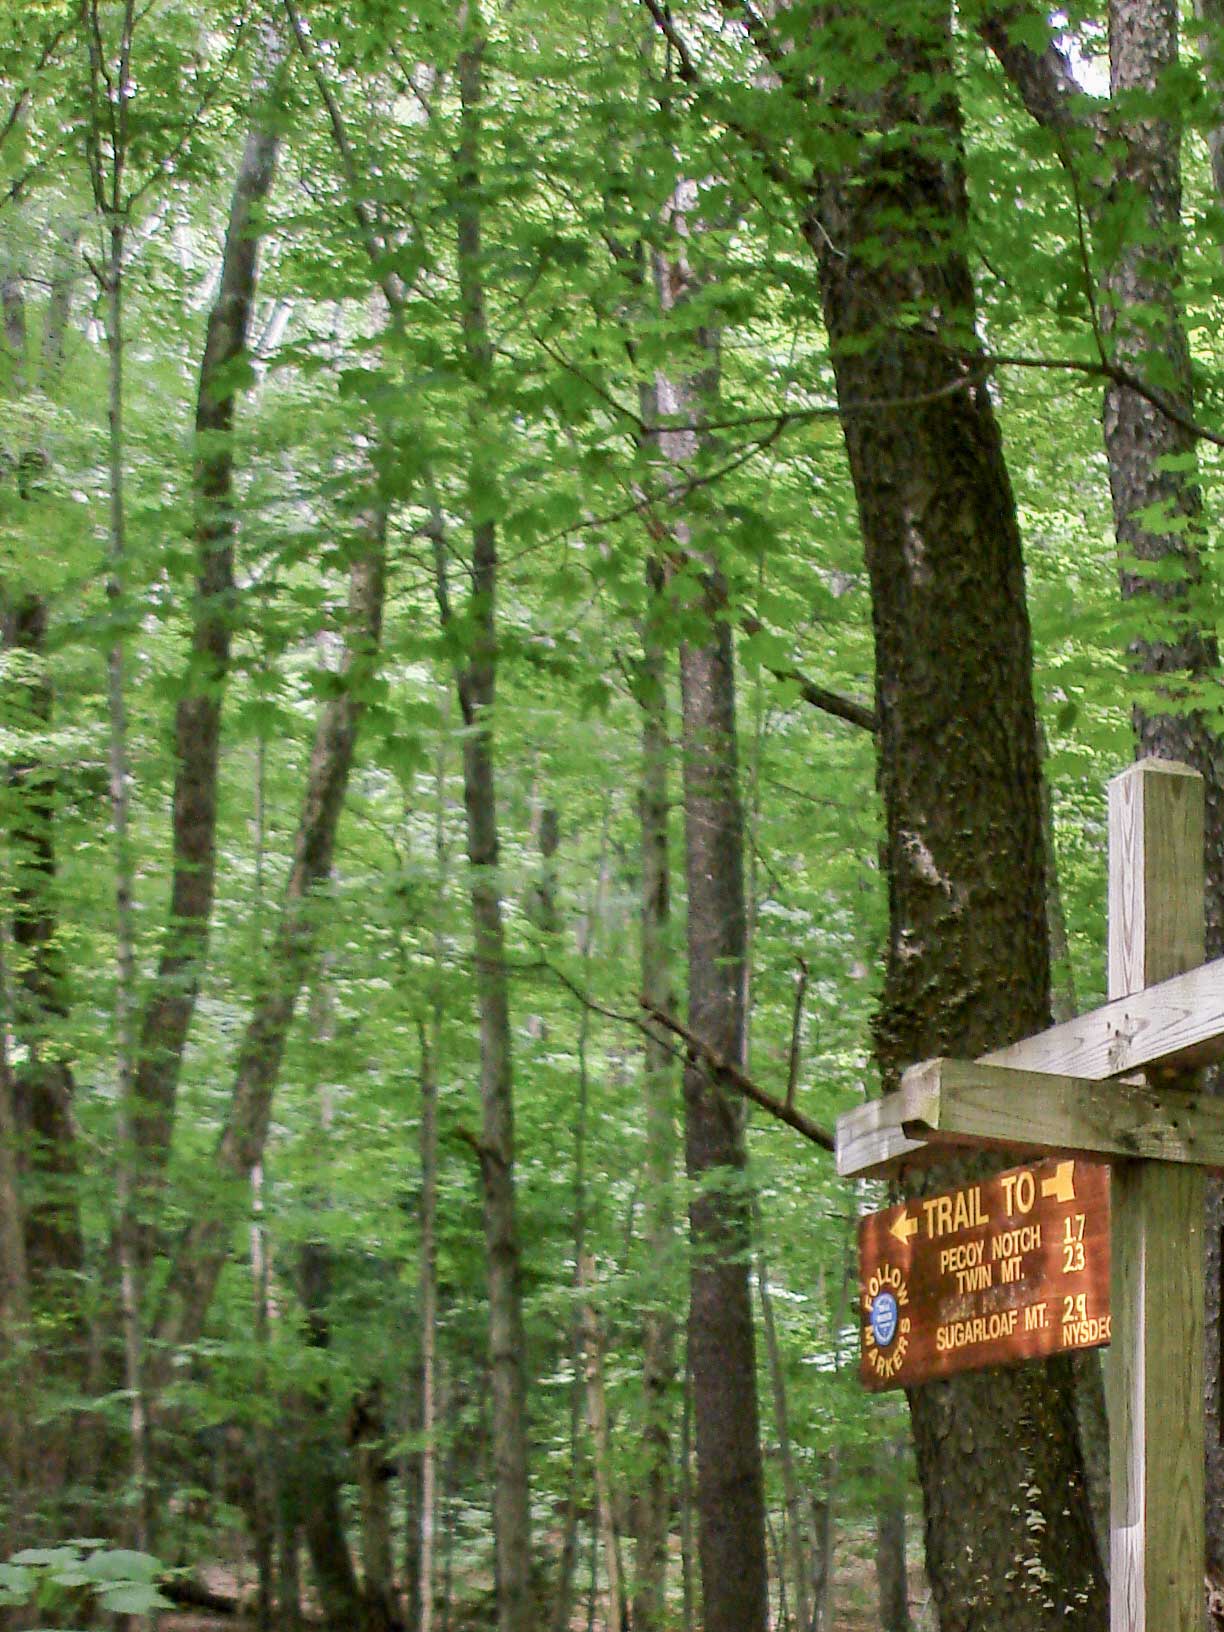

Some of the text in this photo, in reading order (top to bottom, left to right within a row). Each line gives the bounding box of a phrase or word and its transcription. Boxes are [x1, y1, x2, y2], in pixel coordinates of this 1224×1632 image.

[923, 1171, 1035, 1239] TRAIL TO
[941, 1214, 1086, 1274] PECOY NOTCH 1.7
[956, 1243, 1086, 1294] TWIN MT. 2.3
[865, 1264, 909, 1312] FOLLOW
[865, 1318, 910, 1377] MARKERS
[936, 1293, 1087, 1351] SUGARLOAF MT. 2.9
